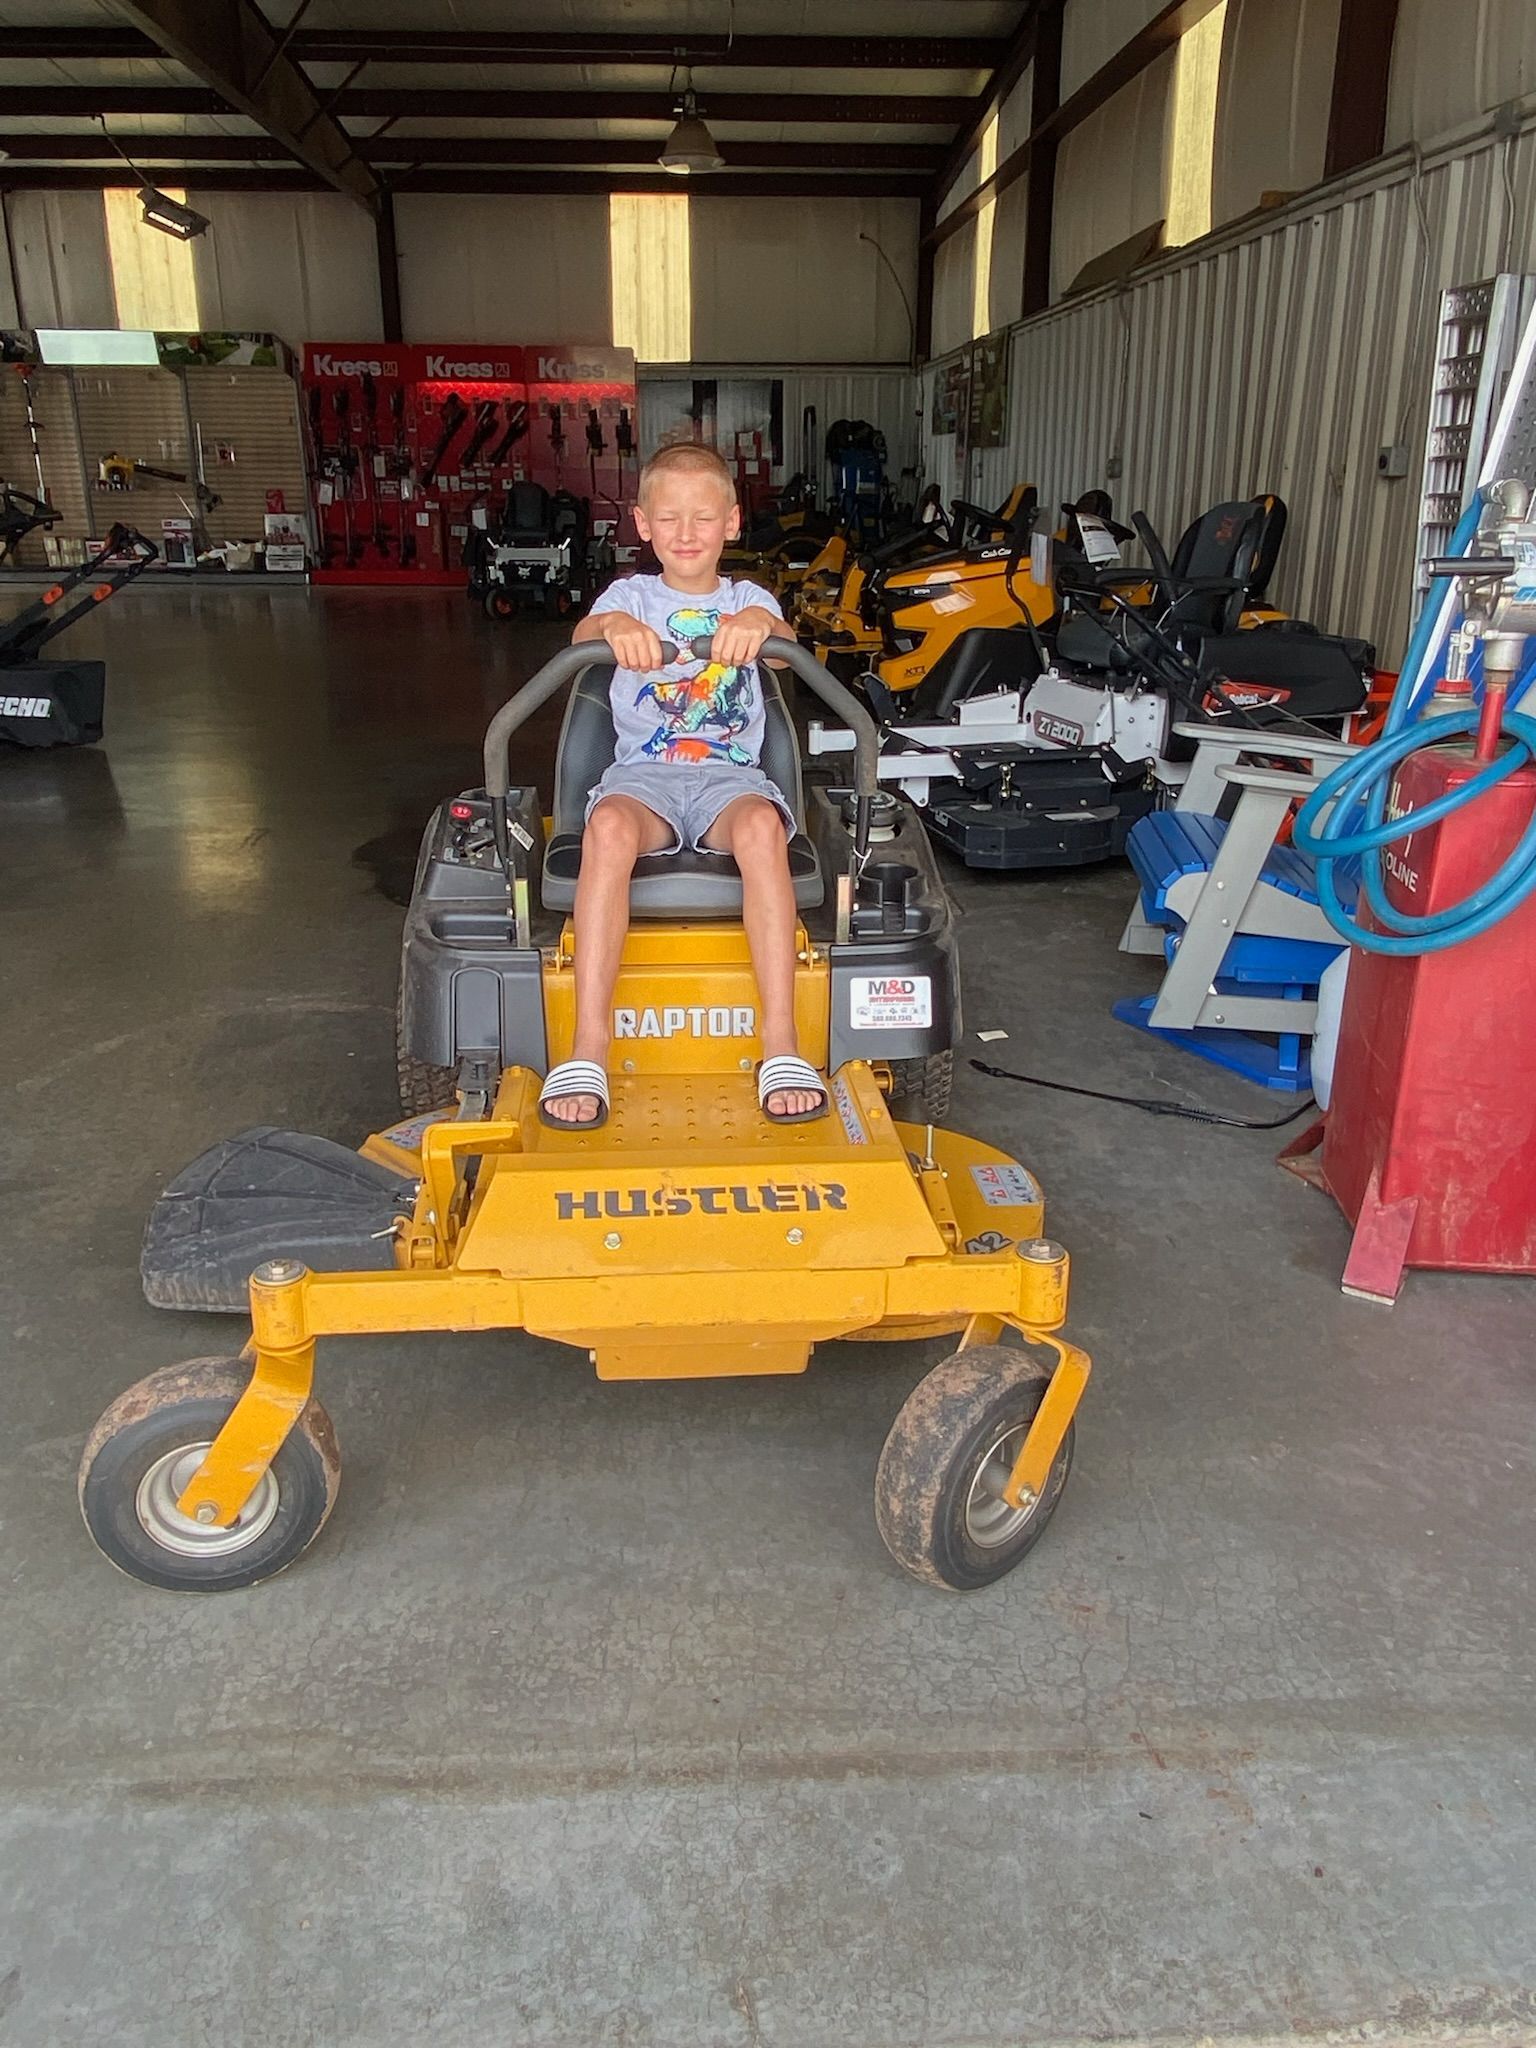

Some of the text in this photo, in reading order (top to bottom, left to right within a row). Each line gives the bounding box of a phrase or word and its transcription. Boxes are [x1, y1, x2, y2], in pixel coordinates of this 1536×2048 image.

[312, 354, 382, 376] Kress
[426, 355, 493, 377] Kress
[538, 357, 606, 378] Kress
[868, 980, 916, 995] M&D
[613, 1007, 756, 1039] RAPTOR
[554, 1183, 848, 1220] HUSTLER
